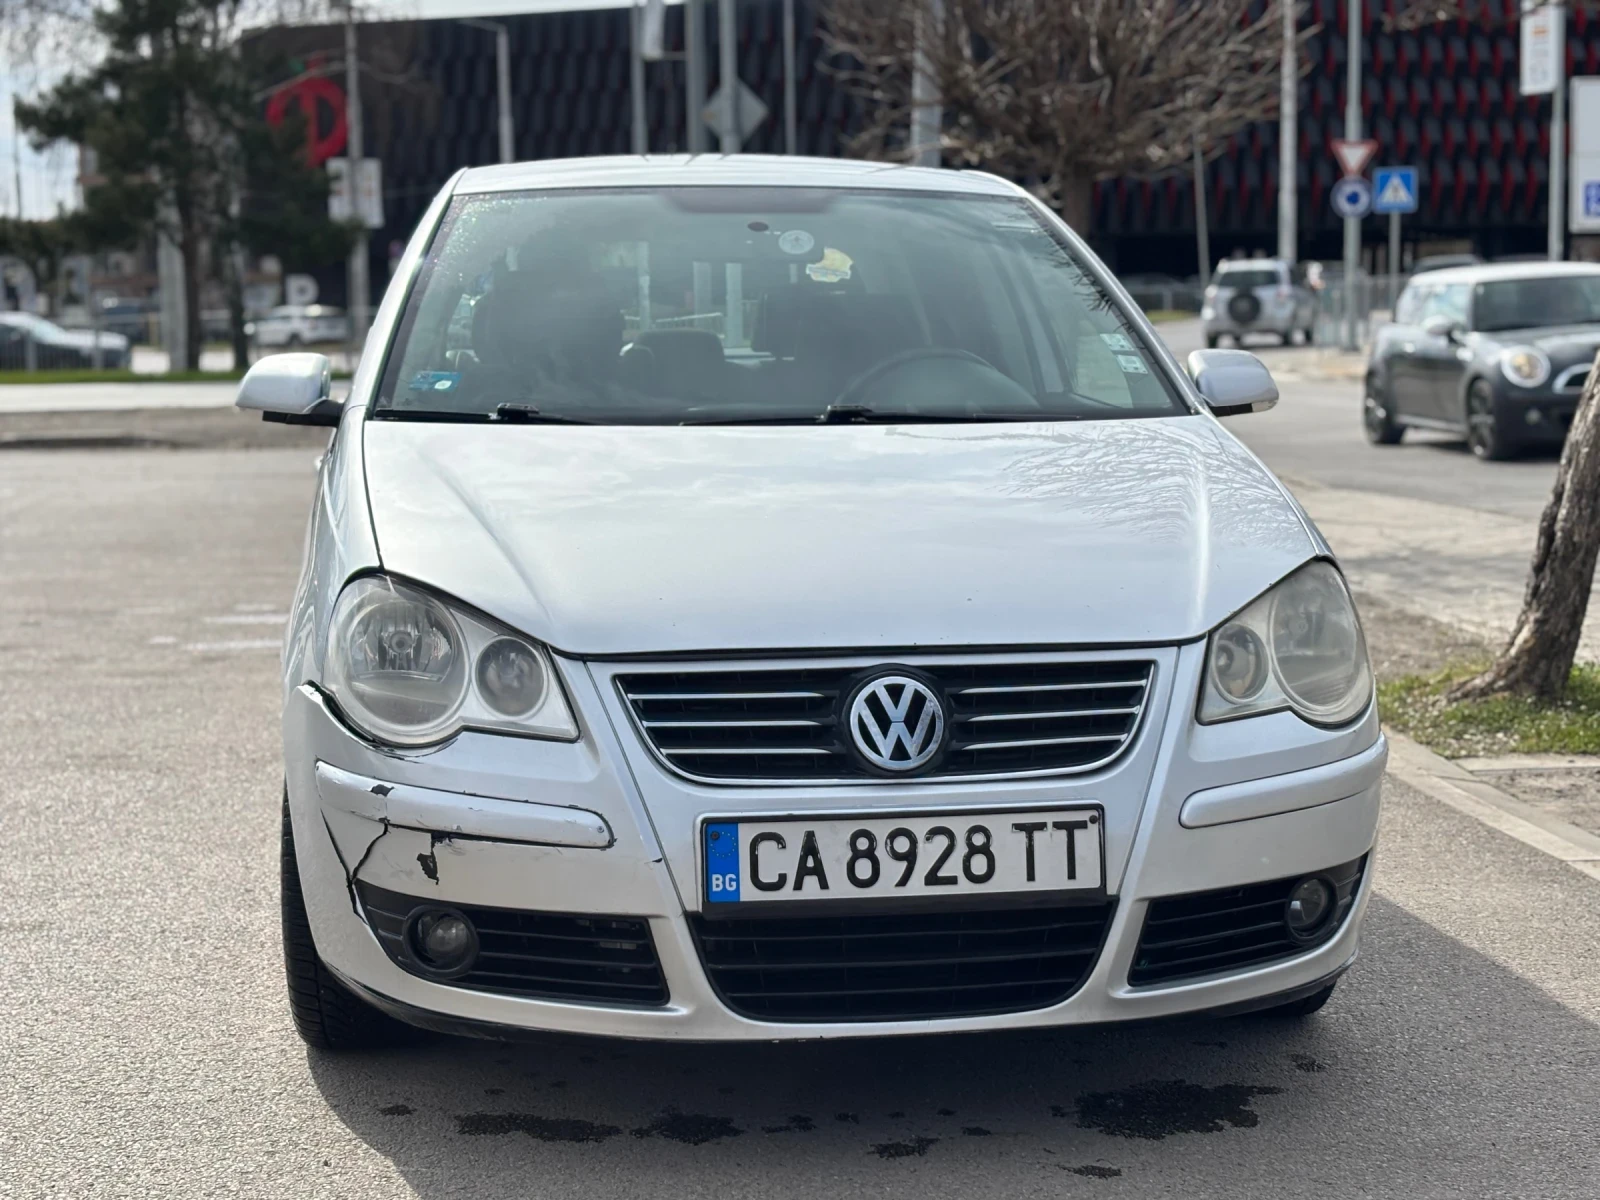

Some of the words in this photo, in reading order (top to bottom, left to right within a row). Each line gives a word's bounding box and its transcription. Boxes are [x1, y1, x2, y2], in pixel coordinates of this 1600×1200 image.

[850, 676, 943, 770] VW
[712, 873, 737, 892] BG
[749, 830, 829, 891] CA
[846, 825, 995, 888] 8928
[1012, 820, 1088, 882] TT
